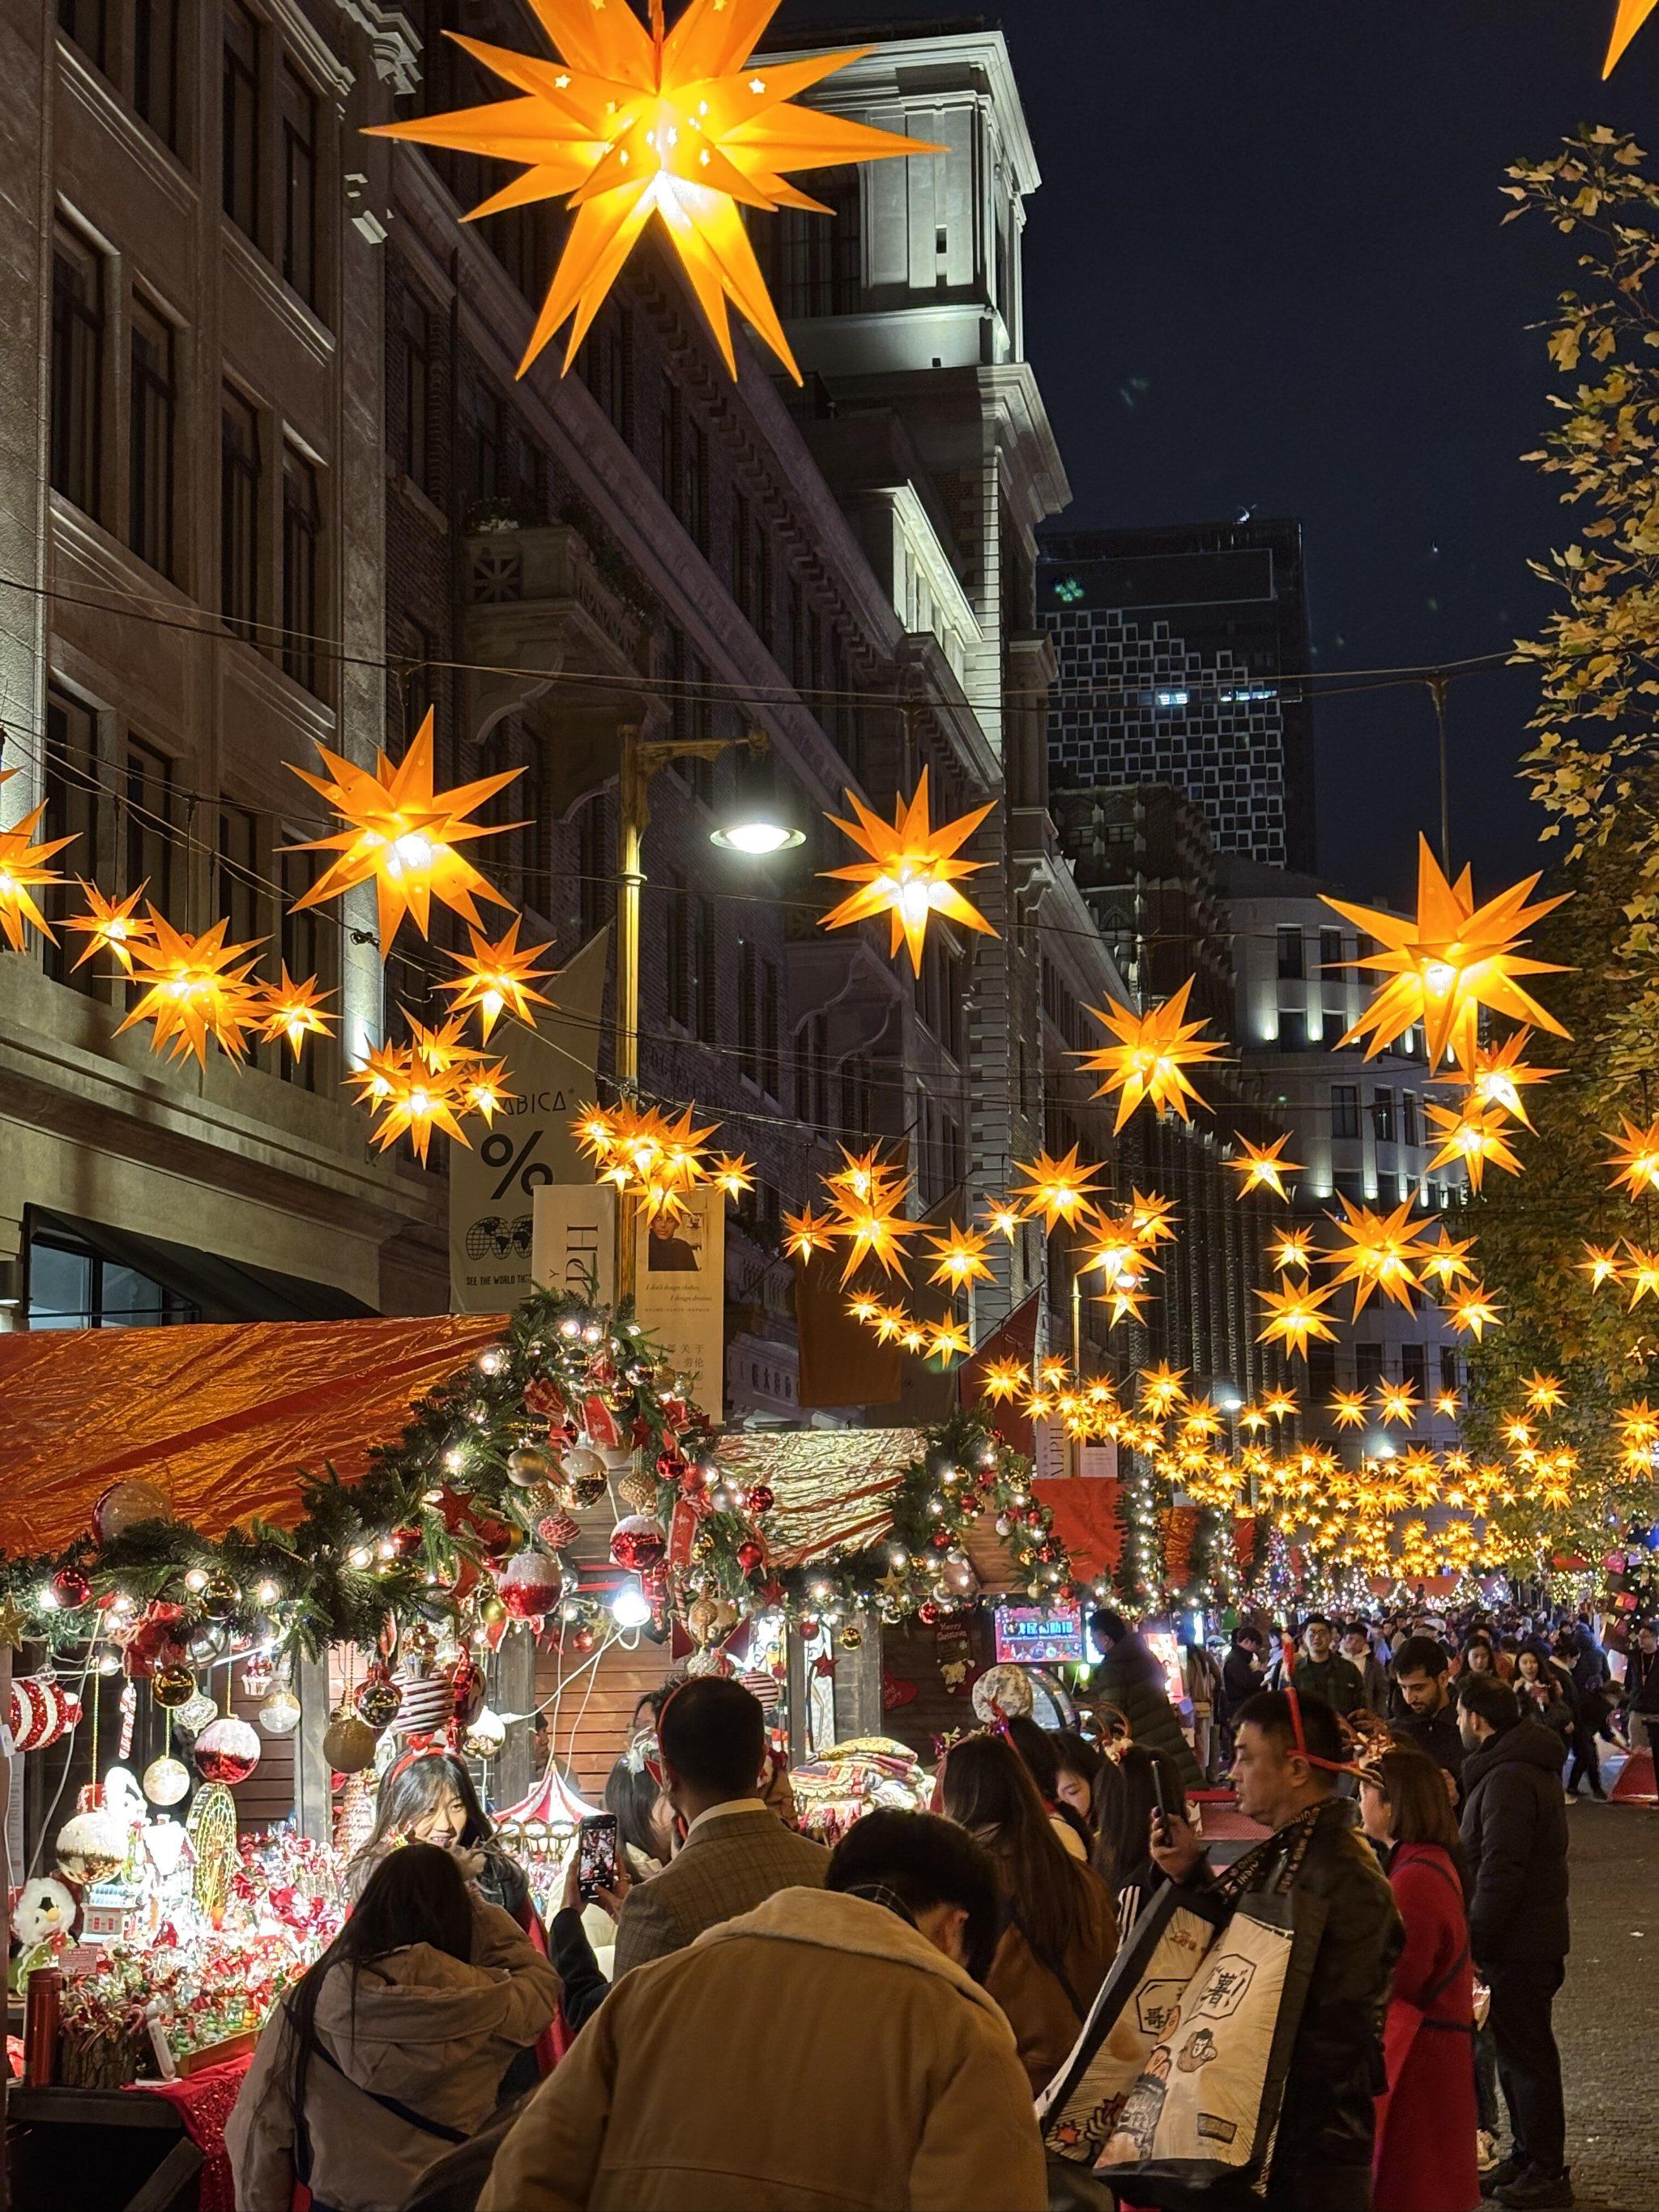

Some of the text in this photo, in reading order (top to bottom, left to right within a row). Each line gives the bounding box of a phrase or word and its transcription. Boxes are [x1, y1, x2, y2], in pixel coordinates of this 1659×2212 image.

[468, 1091, 566, 1117] ABICA
[466, 1276, 478, 1285] SEE
[480, 1276, 492, 1285] THE
[493, 1275, 515, 1285] WORLD
